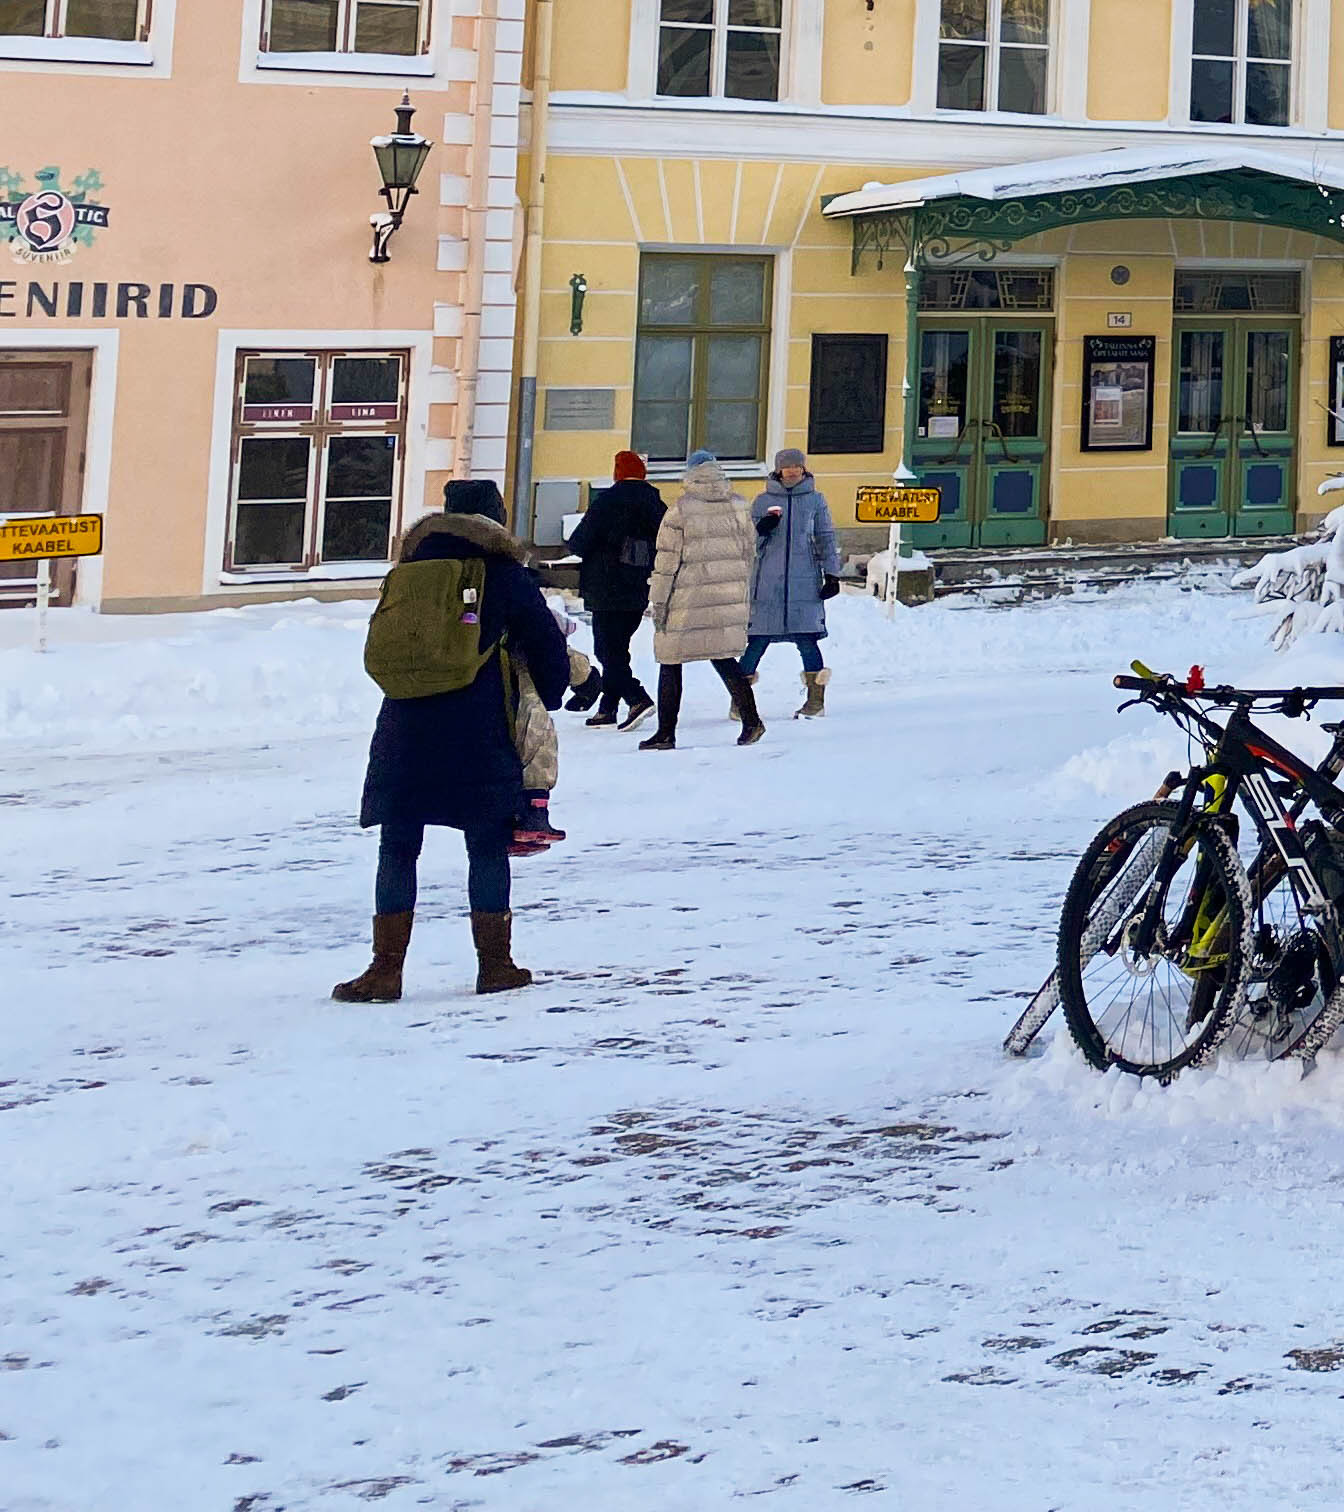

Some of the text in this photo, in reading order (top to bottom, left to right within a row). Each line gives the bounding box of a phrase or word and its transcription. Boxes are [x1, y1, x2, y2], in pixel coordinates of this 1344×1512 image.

[77, 208, 104, 222] TIC
[1114, 315, 1126, 325] 14
[12, 539, 75, 555] KAABEL
